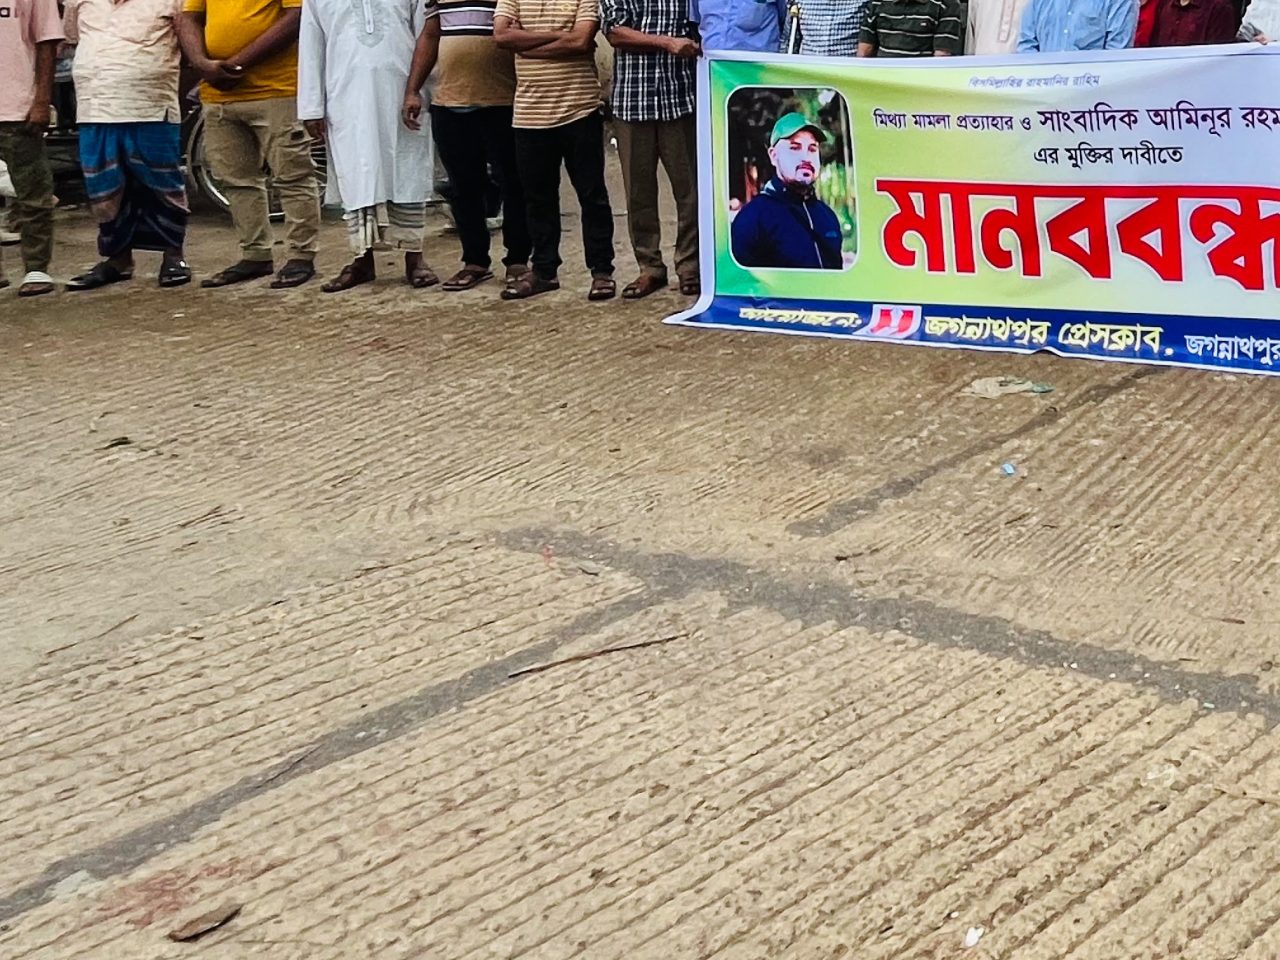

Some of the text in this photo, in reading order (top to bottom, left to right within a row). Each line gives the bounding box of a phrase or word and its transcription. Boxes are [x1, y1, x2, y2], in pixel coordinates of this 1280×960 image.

[968, 74, 1101, 89] বিসমিল্লাহির রাহমানির রাহিম
[873, 108, 906, 129] মিথ্যা
[911, 113, 951, 130] মামলা
[956, 115, 1014, 131] প্রত্যাহার
[1019, 117, 1032, 131] ও
[1037, 102, 1140, 133] সাংবাদিক
[1146, 100, 1232, 138] আমিনূর
[1033, 140, 1184, 170] এর মুক্তির দাবীতে
[924, 315, 1052, 344] জগন্নাথপুর
